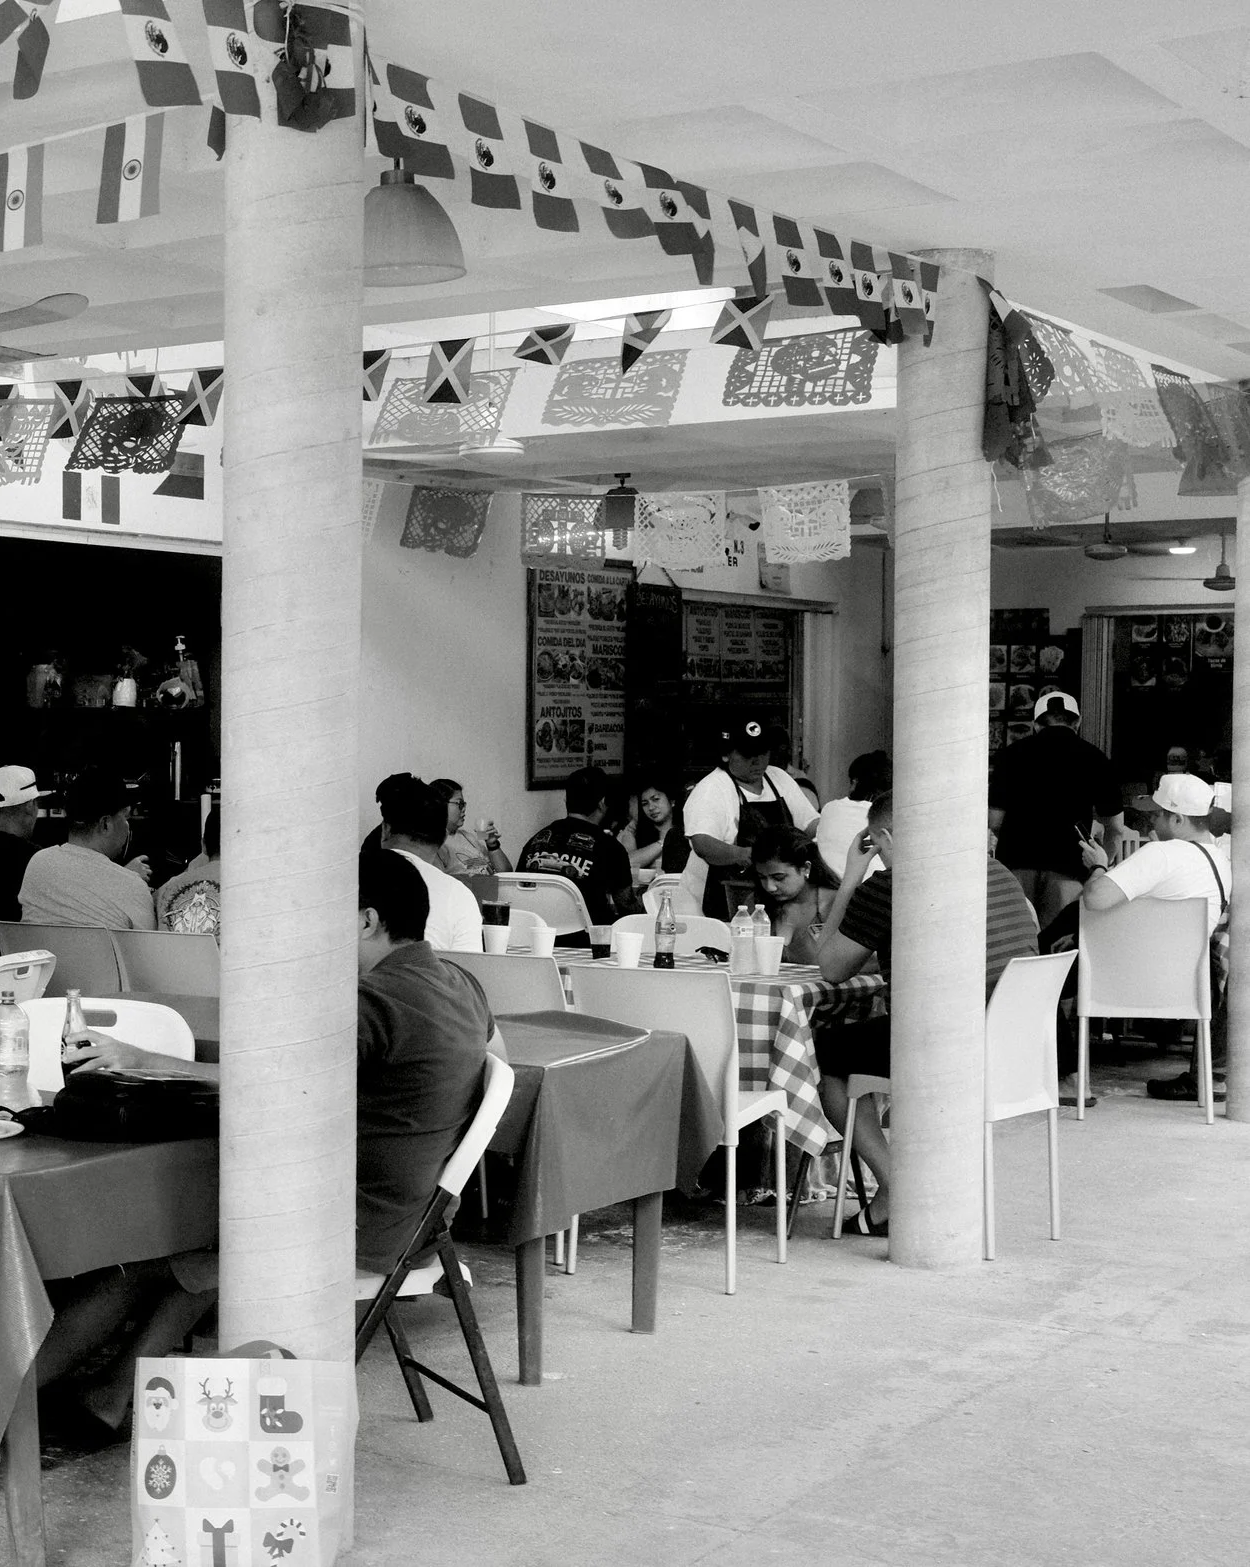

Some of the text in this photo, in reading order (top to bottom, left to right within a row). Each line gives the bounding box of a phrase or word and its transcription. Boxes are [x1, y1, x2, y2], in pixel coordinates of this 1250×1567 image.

[540, 570, 585, 584] DESAYUNOS
[538, 636, 562, 646] COMIDA
[563, 637, 574, 647] DEL
[540, 706, 582, 718] ANTOJITOS
